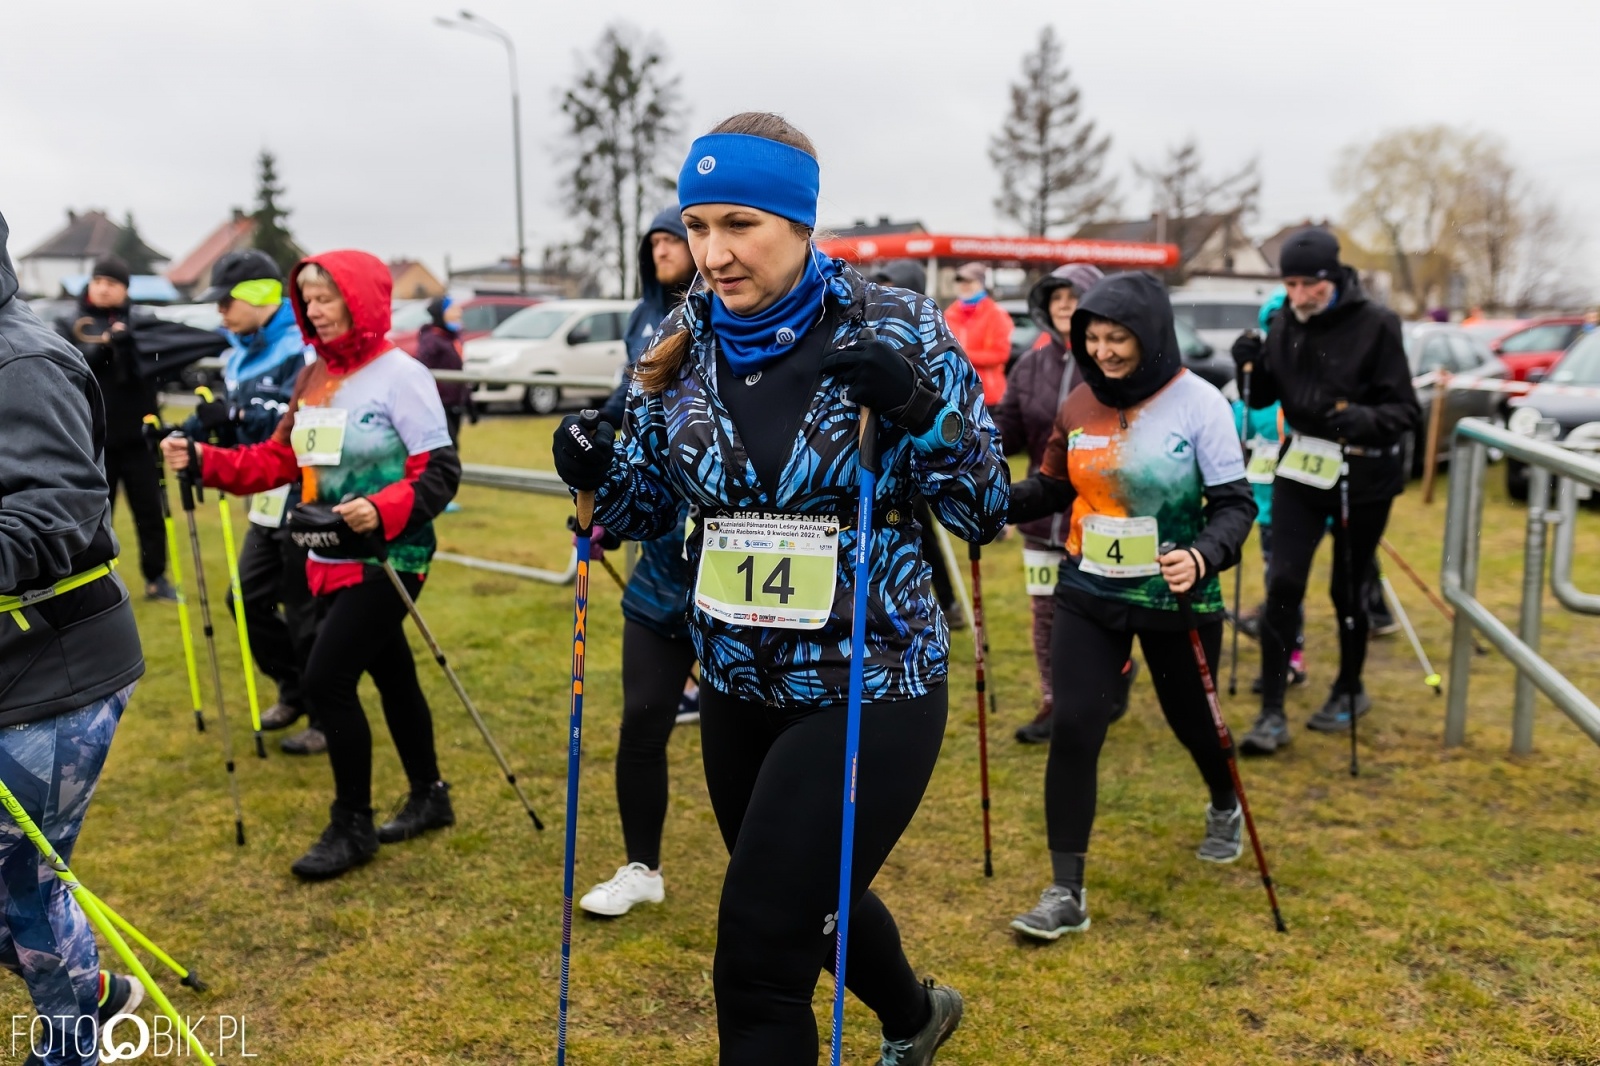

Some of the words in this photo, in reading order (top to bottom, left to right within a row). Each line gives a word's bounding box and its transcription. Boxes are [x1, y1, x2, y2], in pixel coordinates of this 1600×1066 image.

[306, 429, 316, 451] 8
[568, 424, 593, 451] SELECT
[1302, 454, 1324, 475] 13
[260, 496, 270, 514] 2
[736, 528, 766, 536] Raciborska,
[746, 521, 778, 529] Półmaraton
[779, 523, 798, 531] Leśny
[291, 531, 341, 548] SPORTS
[1106, 539, 1124, 563] 4
[737, 556, 794, 604] 14
[1029, 566, 1051, 585] 10
[572, 560, 588, 716] EXEL
